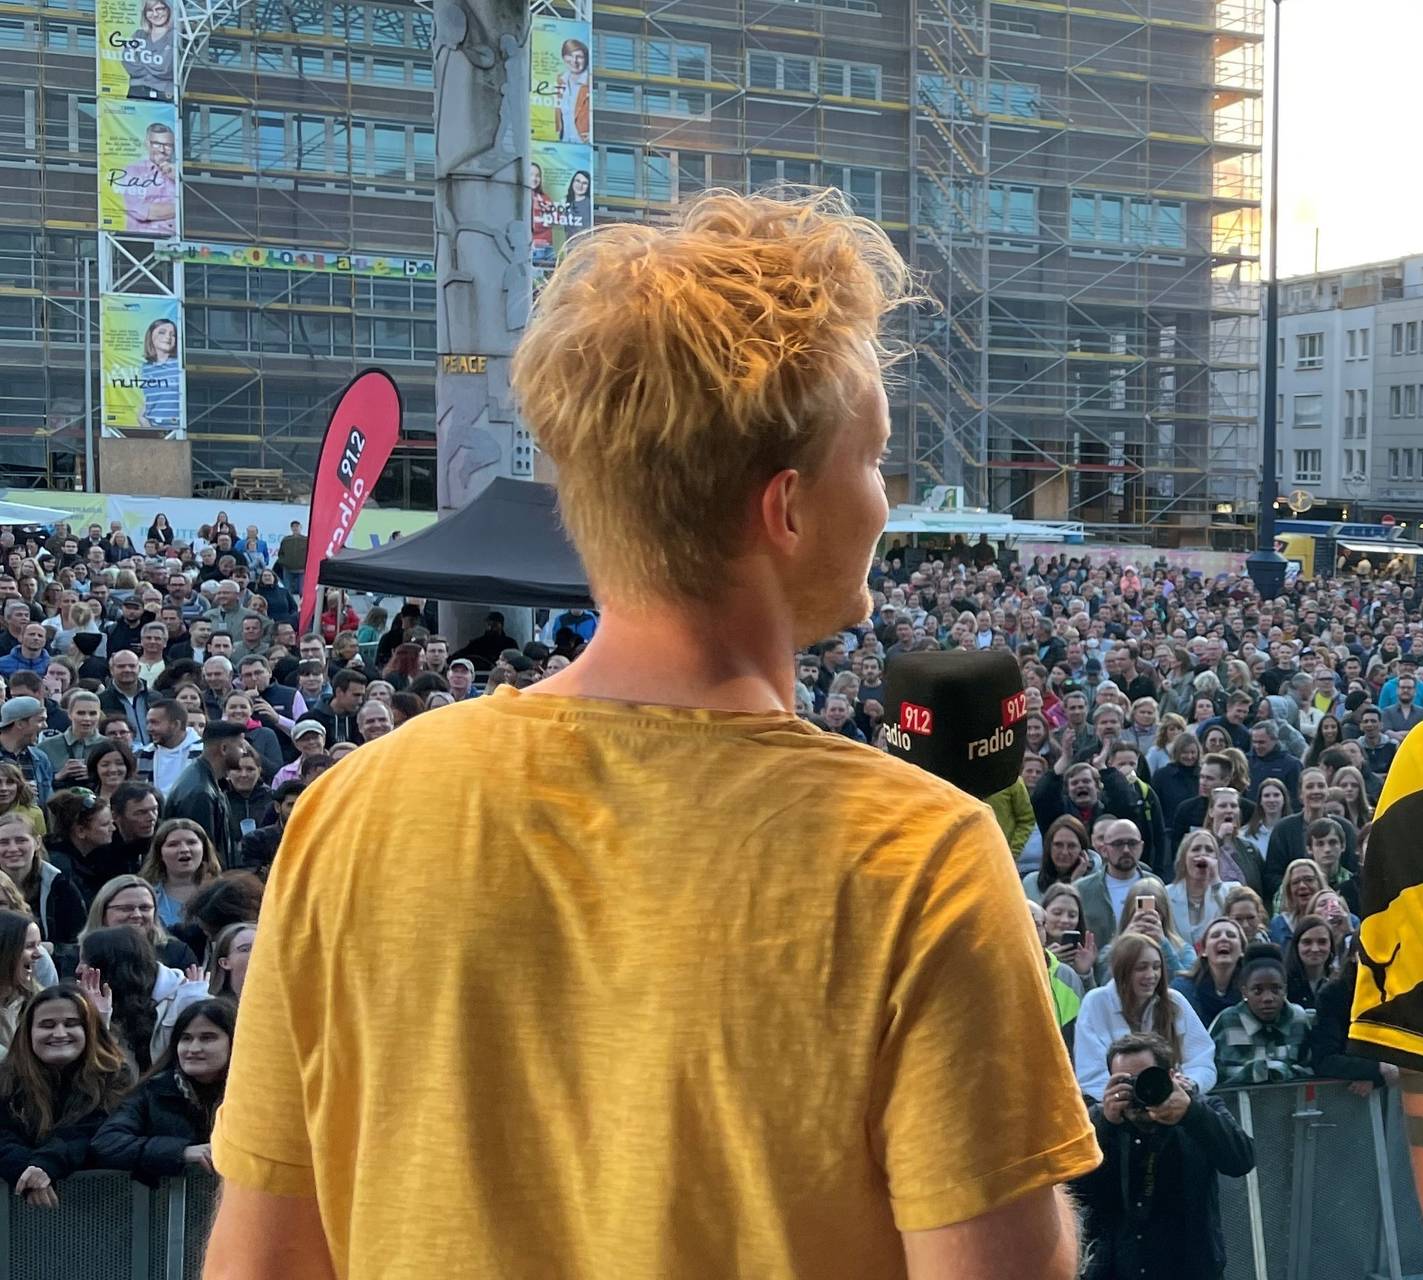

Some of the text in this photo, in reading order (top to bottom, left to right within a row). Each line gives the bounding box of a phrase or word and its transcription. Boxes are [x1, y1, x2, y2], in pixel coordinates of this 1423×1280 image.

[106, 168, 162, 187] Rad
[442, 355, 488, 374] PEACE
[112, 374, 169, 389] nutzen
[341, 431, 365, 478] 91.2
[325, 478, 364, 558] radio
[905, 706, 931, 733] 91.2
[1007, 694, 1027, 722] 91.2
[968, 726, 1014, 760] radio
